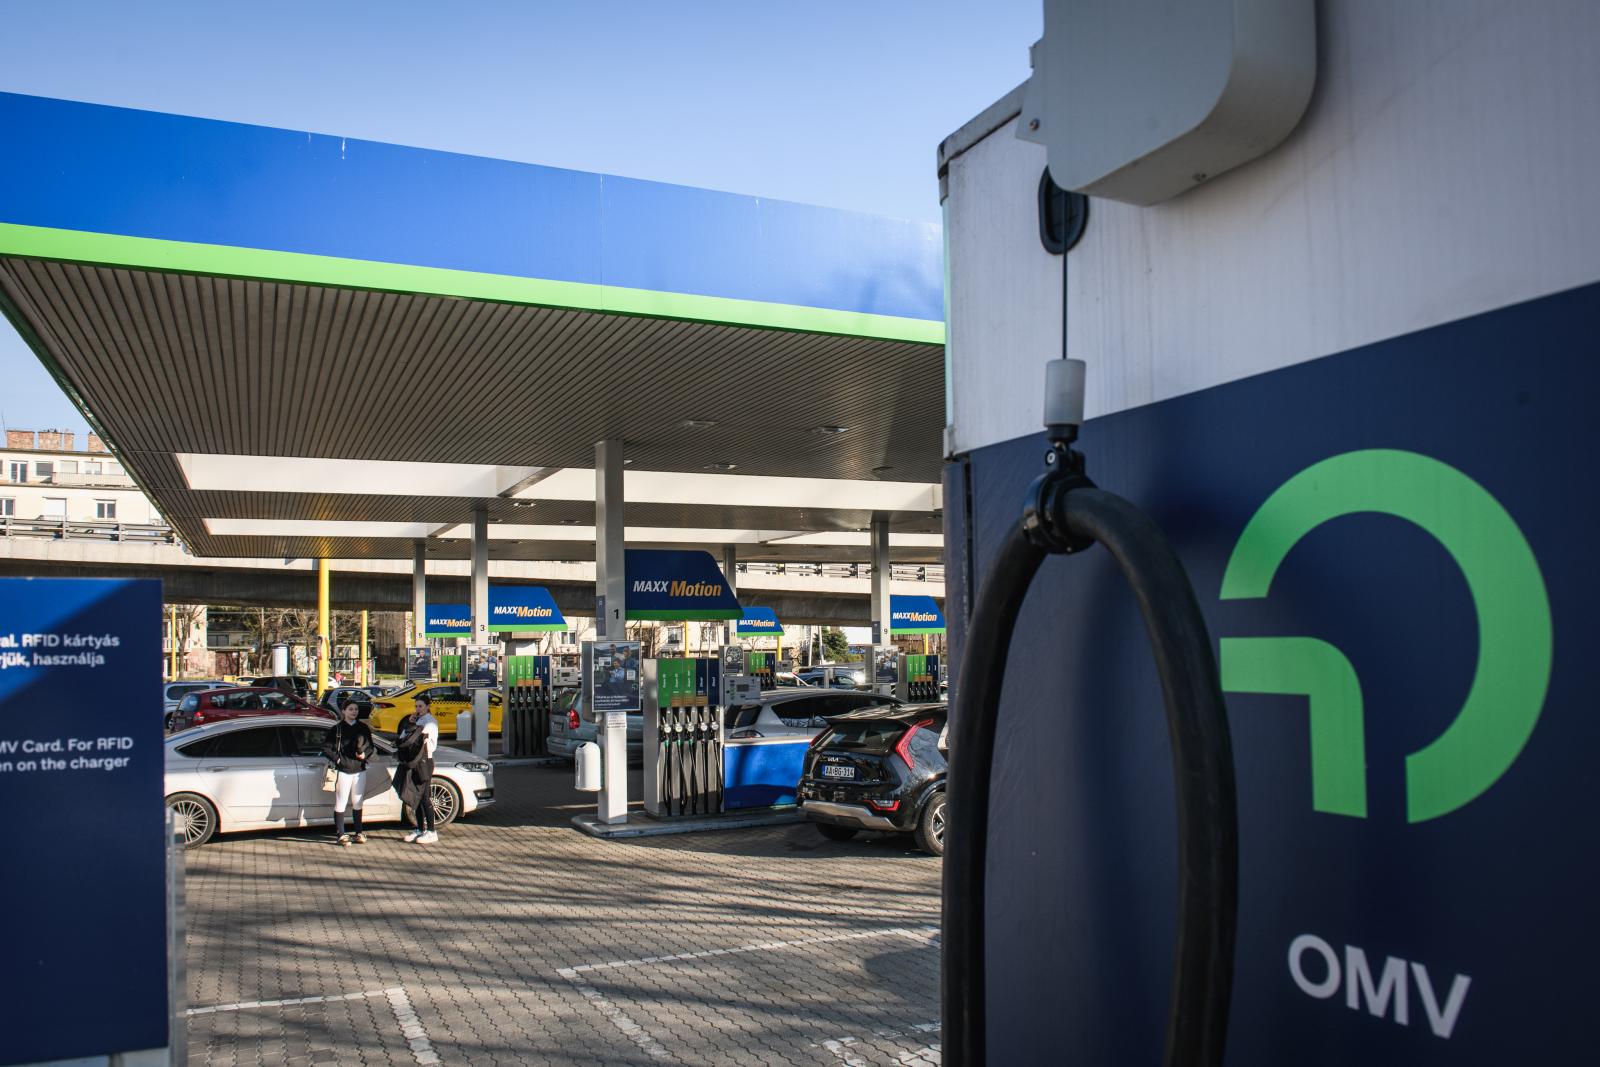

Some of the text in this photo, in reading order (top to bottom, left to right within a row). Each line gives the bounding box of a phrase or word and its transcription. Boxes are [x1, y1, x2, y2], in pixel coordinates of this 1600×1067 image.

[633, 580, 722, 597] MAXX Motion
[494, 605, 552, 617] MAXX Motion
[613, 609, 619, 619] 1
[893, 611, 937, 622] MAXX Motion
[480, 624, 486, 632] 3
[752, 619, 775, 628] Motion
[0, 633, 120, 650] al. RFID kártyás
[33, 652, 105, 668] használja
[22, 738, 64, 753] Card.
[68, 738, 93, 751] For
[97, 737, 134, 750] RFID
[16, 761, 37, 771] on
[41, 757, 67, 770] the
[70, 756, 130, 771] charger
[1288, 933, 1472, 1040] OMV
